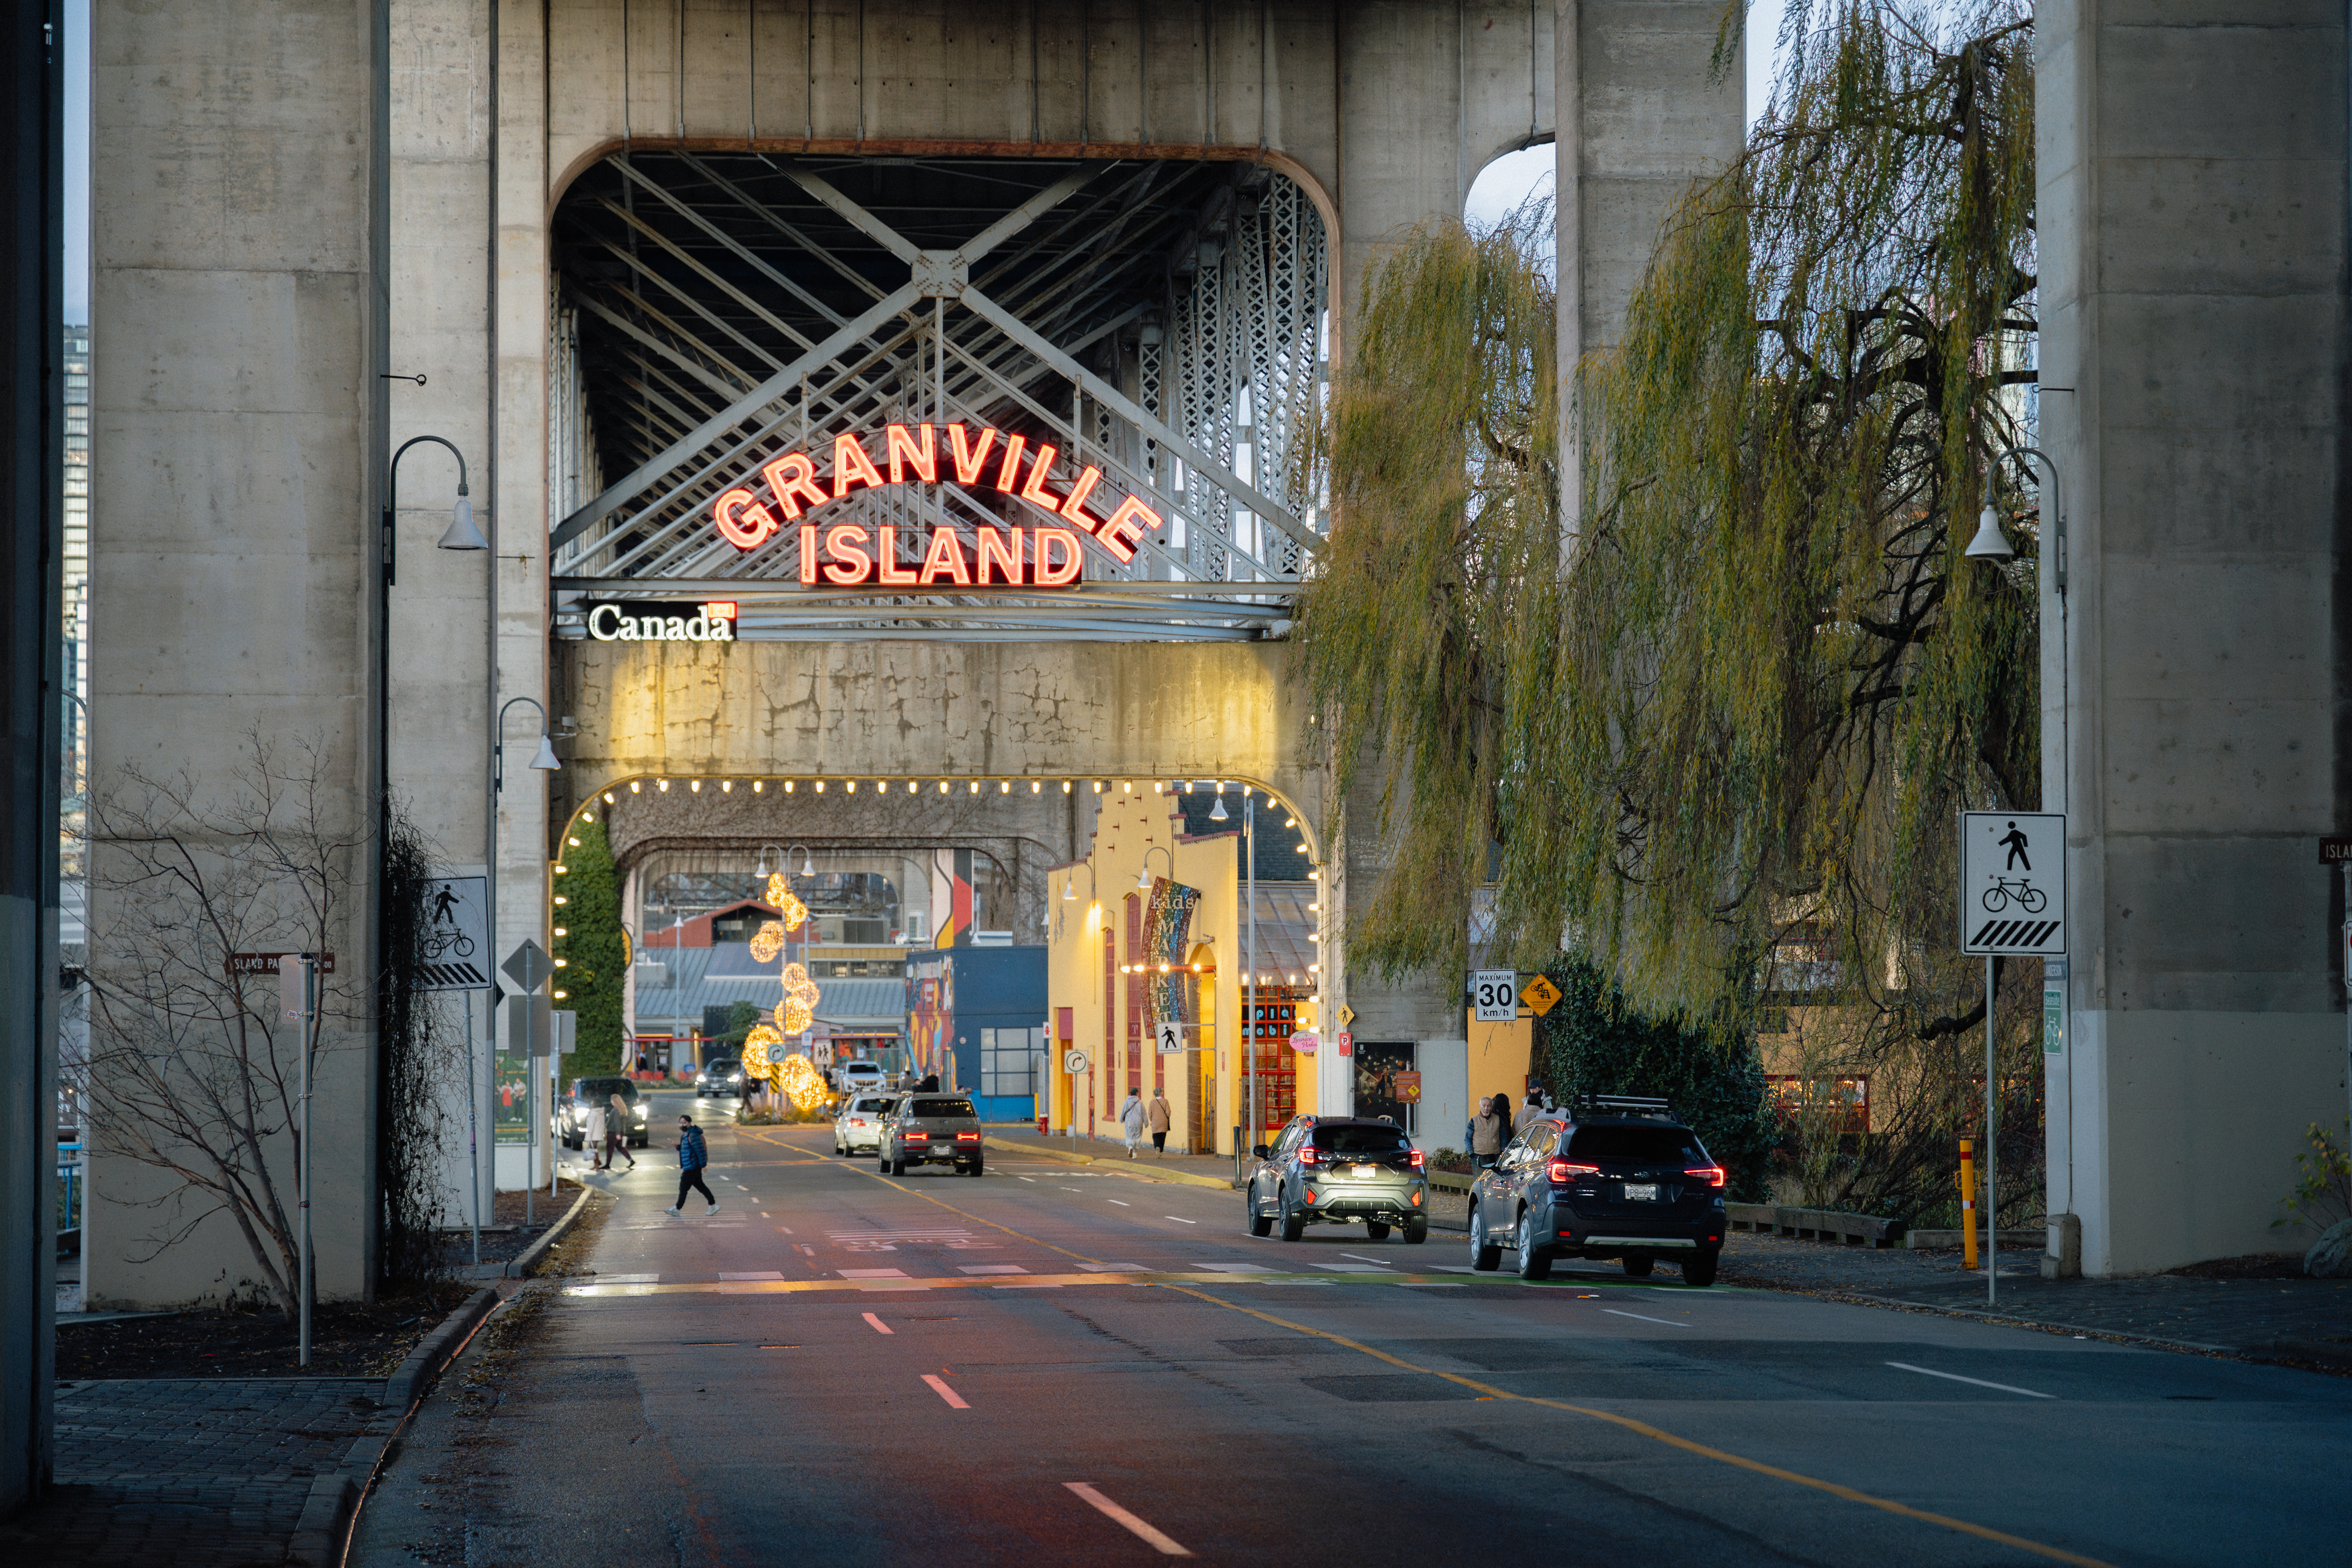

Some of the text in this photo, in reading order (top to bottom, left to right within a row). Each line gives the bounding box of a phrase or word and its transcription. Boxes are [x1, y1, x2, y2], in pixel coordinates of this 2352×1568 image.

[714, 423, 1163, 563] GRANVILLE
[800, 525, 1082, 585] ISLAND
[588, 604, 734, 641] Canada
[1151, 894, 1194, 909] kids
[234, 958, 263, 969] SLAND
[1479, 983, 1512, 1007] 30
[1483, 1008, 1509, 1017] km/h
